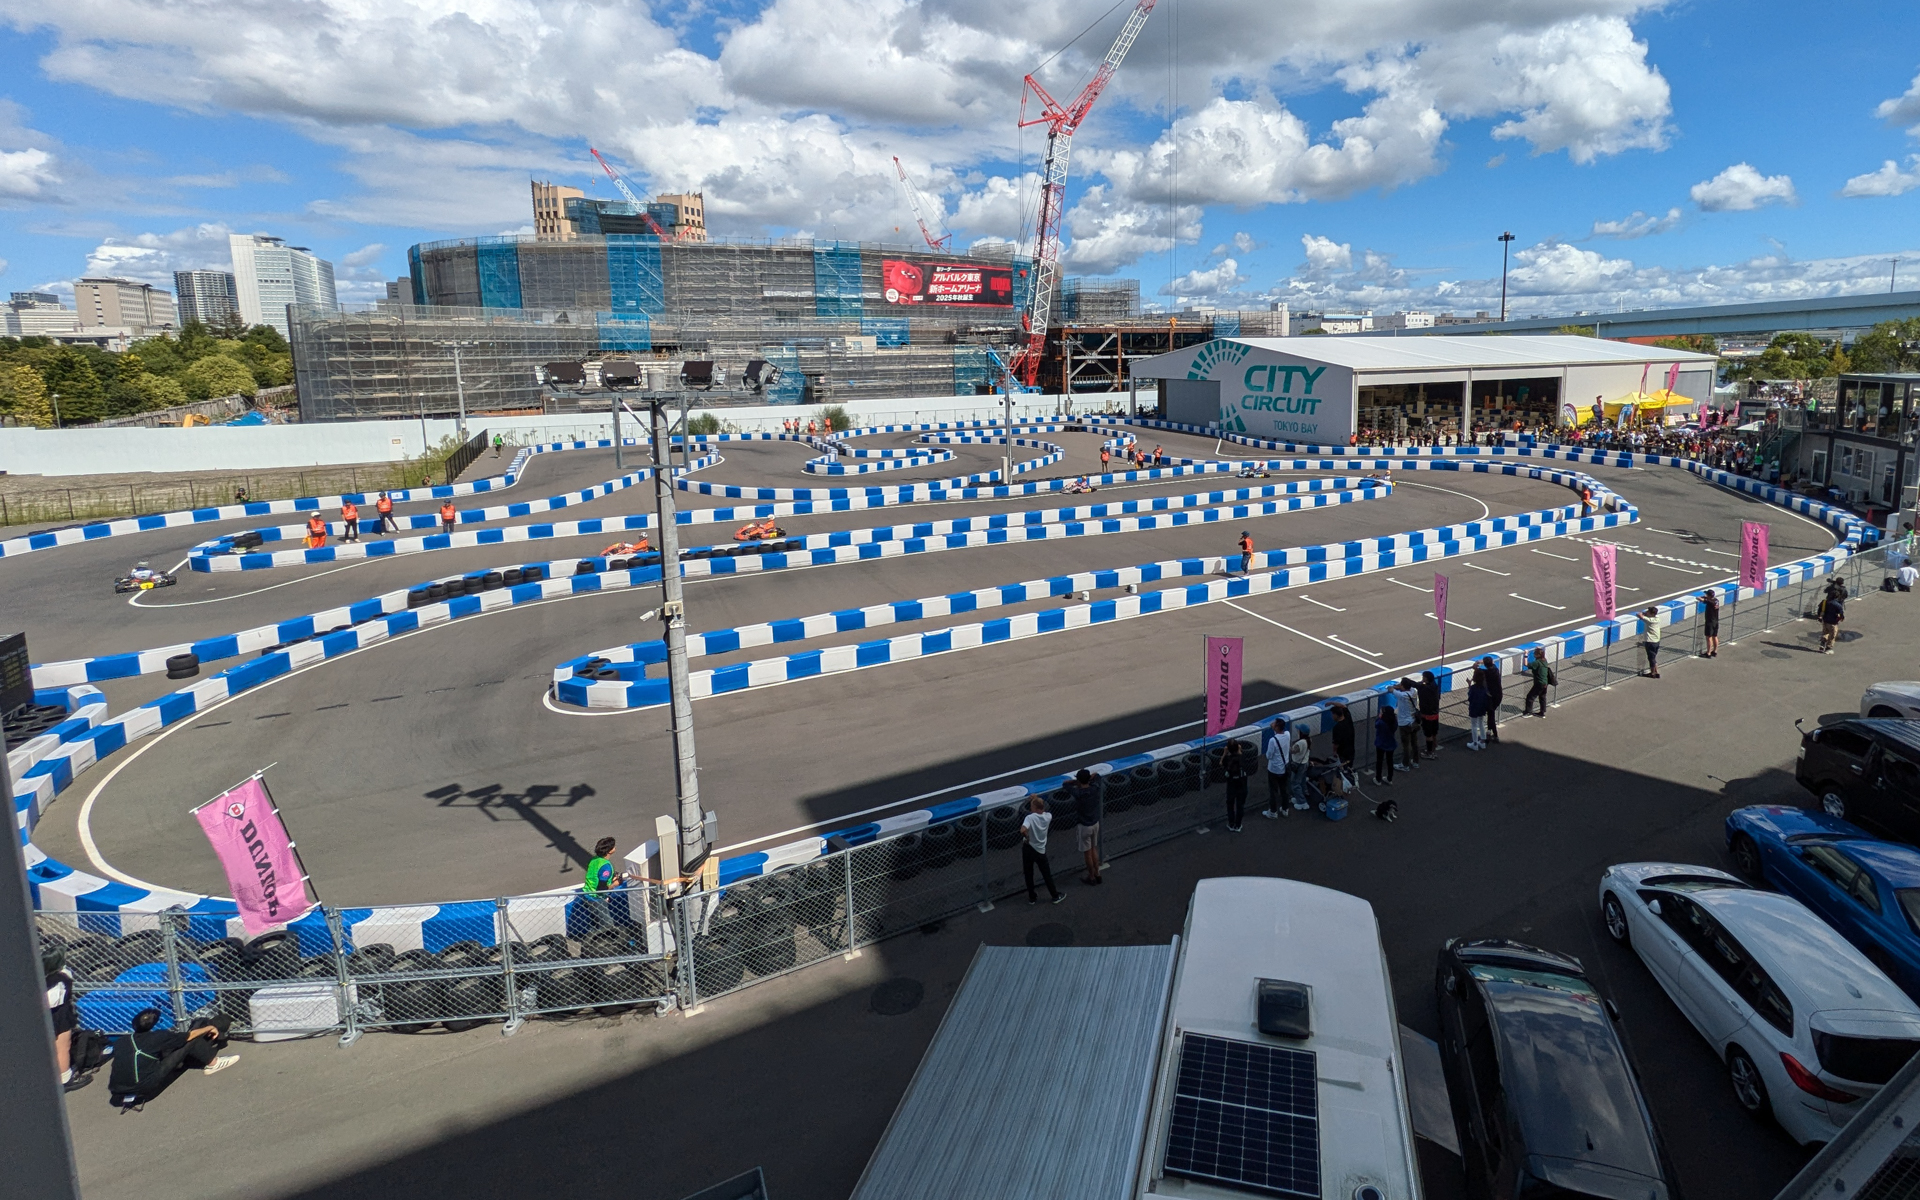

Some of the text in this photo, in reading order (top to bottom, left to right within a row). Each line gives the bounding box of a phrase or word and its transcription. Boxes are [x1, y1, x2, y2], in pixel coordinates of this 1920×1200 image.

[933, 273, 981, 282] アルバルク東京
[929, 284, 982, 293] 新ホームアリーナ
[1244, 365, 1327, 395] CITY
[1241, 394, 1322, 415] CIRCUIT
[1273, 420, 1318, 434] TOKYO BAY
